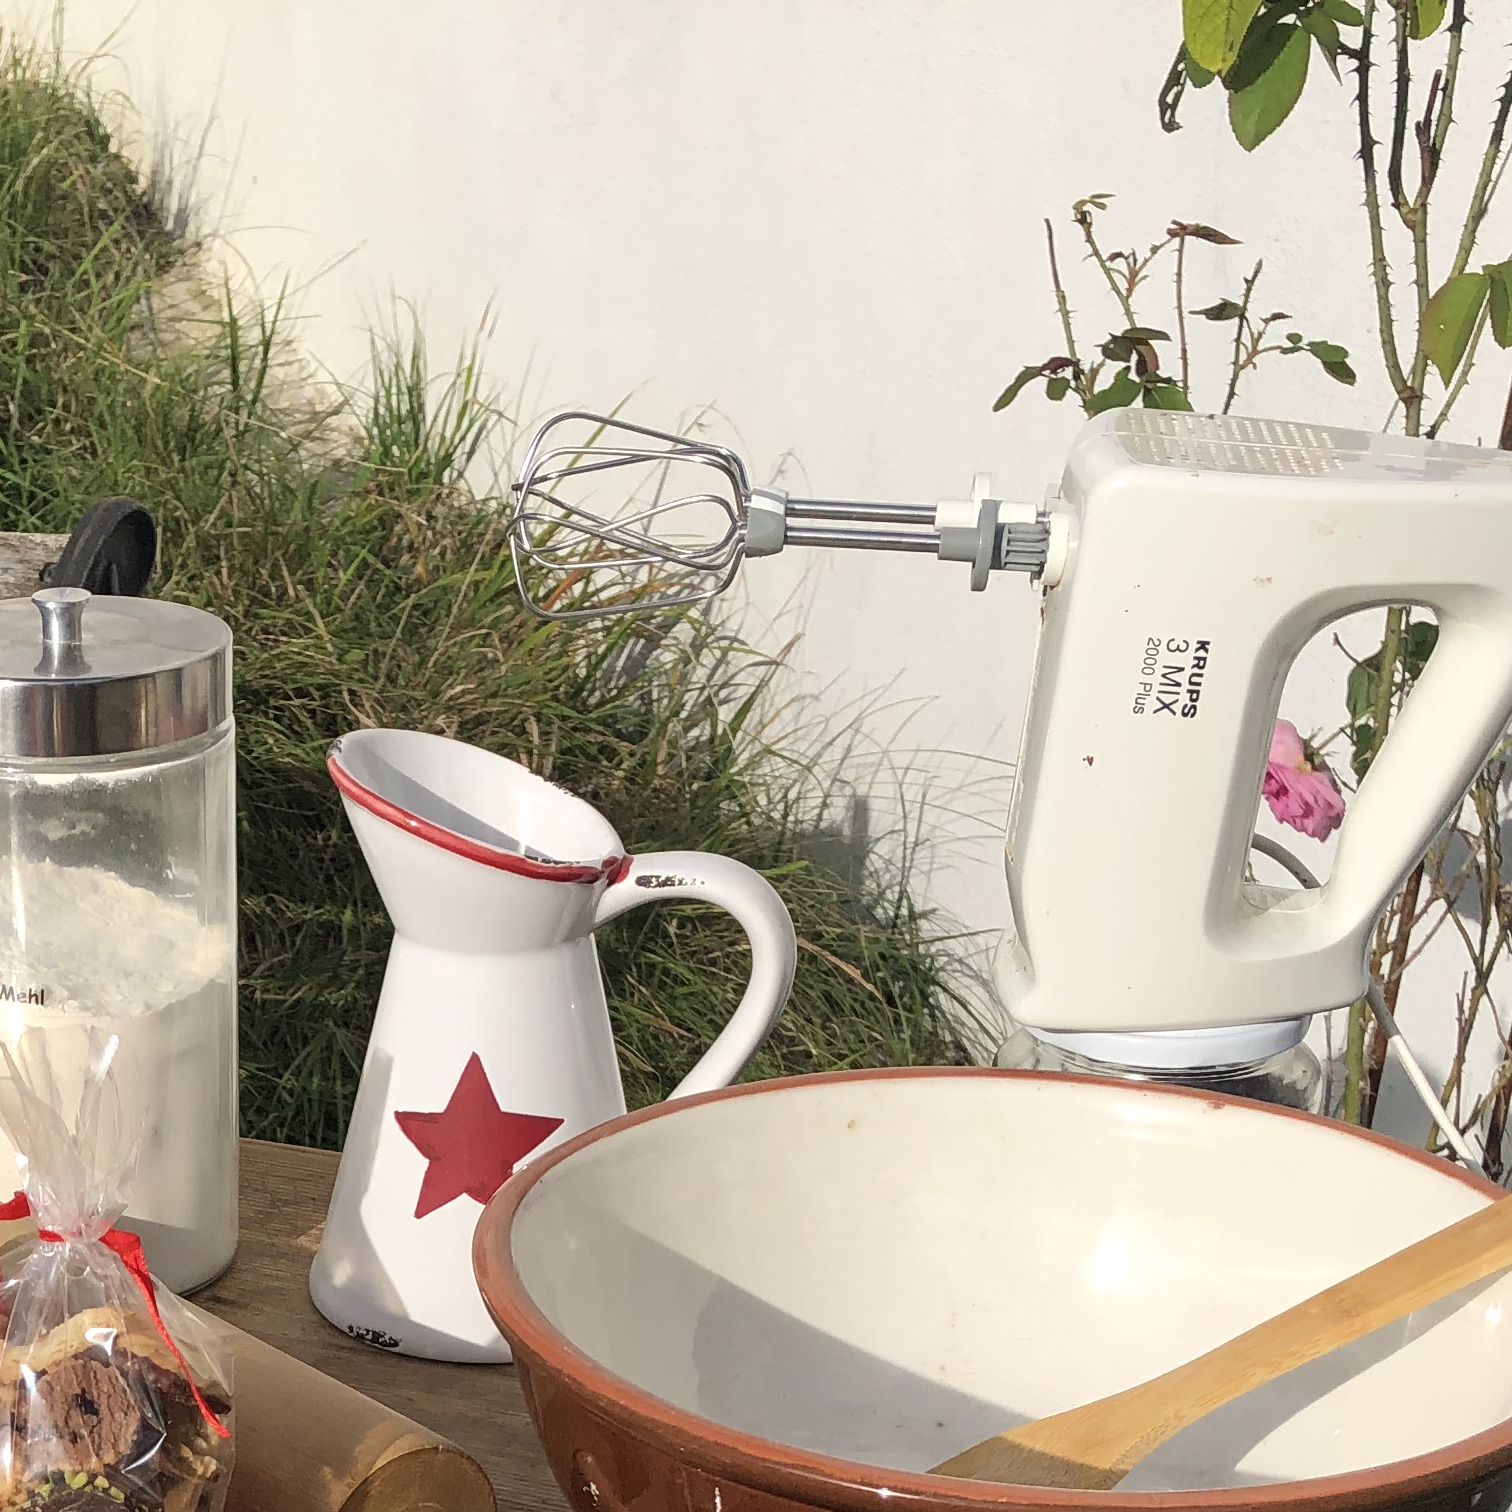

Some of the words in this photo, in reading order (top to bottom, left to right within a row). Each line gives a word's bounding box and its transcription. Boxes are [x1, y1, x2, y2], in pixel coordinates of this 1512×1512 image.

[1141, 637, 1161, 676] 2000
[1166, 638, 1189, 653] 3
[1153, 665, 1185, 716] MIX
[1181, 640, 1211, 718] KRUPS
[1133, 682, 1153, 714] Plus
[0, 984, 44, 1005] Mehl
